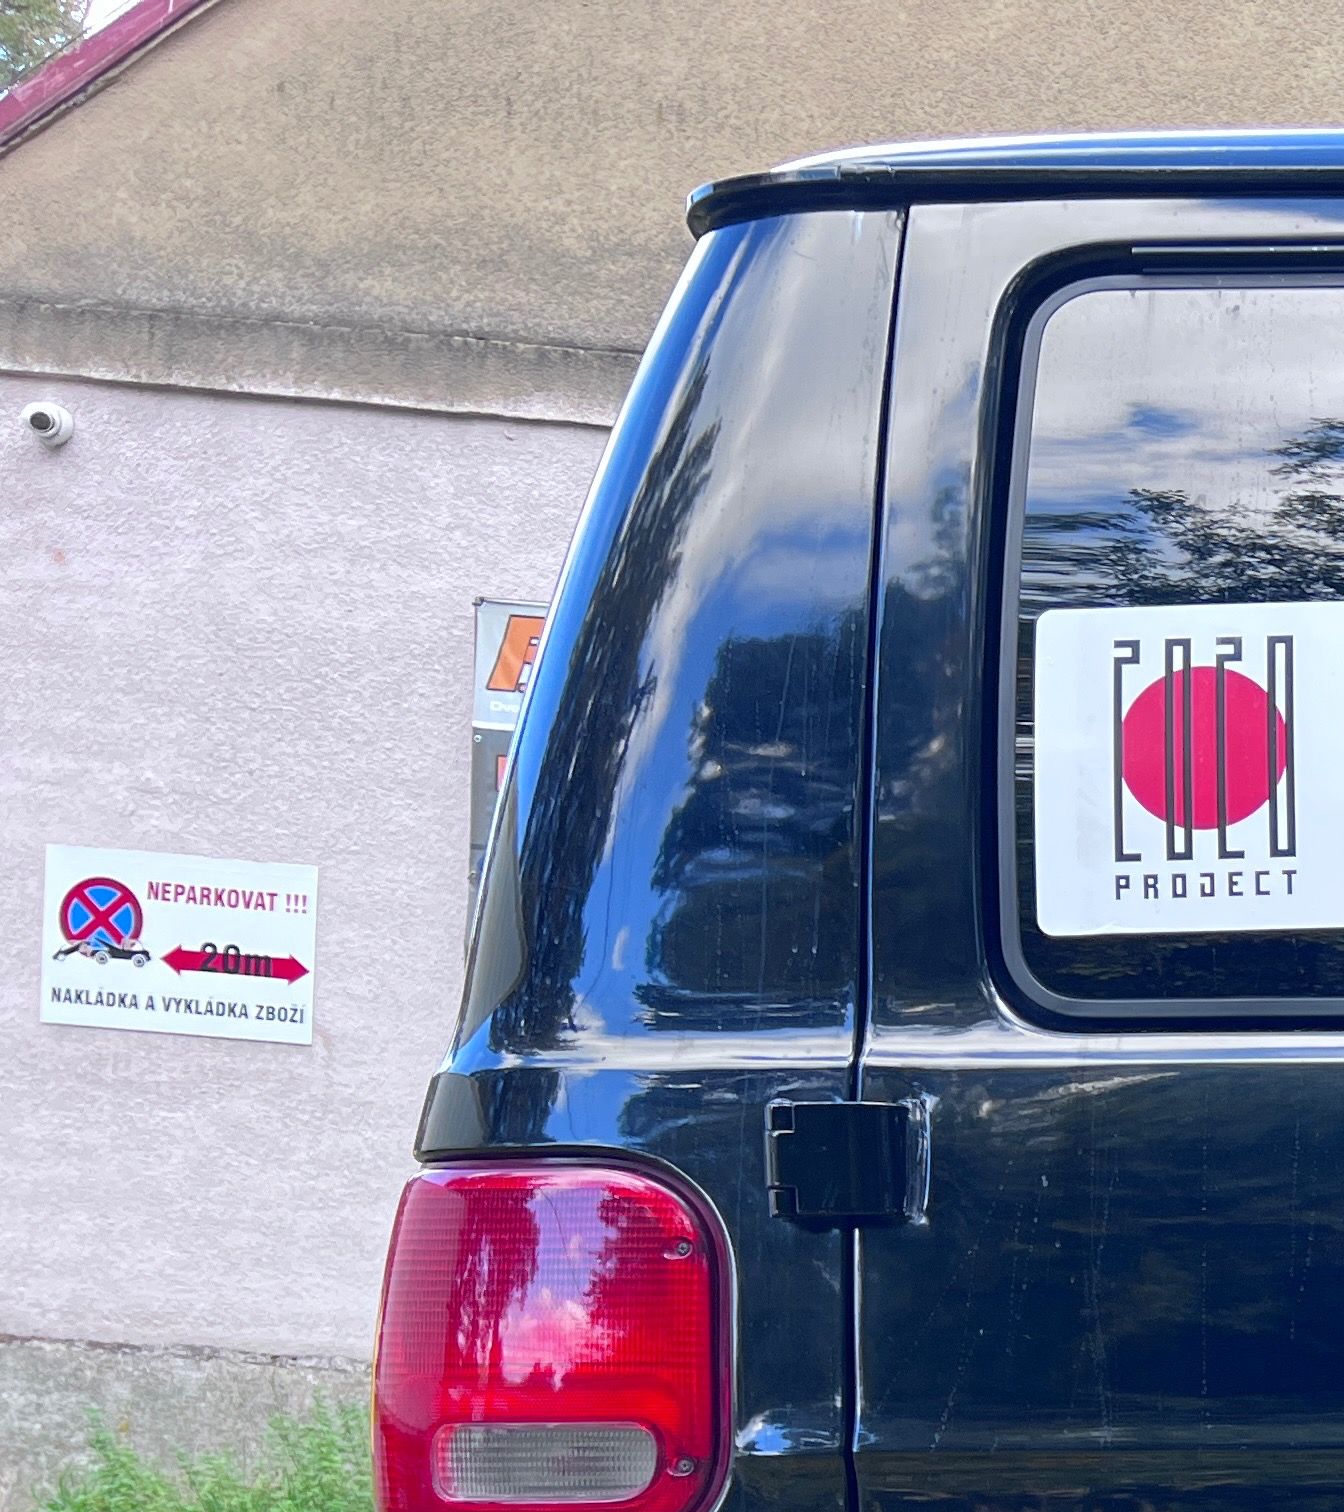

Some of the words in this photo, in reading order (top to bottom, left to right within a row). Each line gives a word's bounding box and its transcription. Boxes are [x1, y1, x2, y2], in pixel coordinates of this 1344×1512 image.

[1113, 635, 1296, 862] 2020
[147, 881, 278, 912] NEPARKOVAT
[1114, 869, 1298, 900] PROJECT
[200, 942, 272, 977] 20m
[51, 986, 139, 1010] NAKLÁDKA
[145, 996, 155, 1011] A
[162, 997, 249, 1020] VYKLÁDKA
[255, 1003, 305, 1024] ZBOŽÍ
